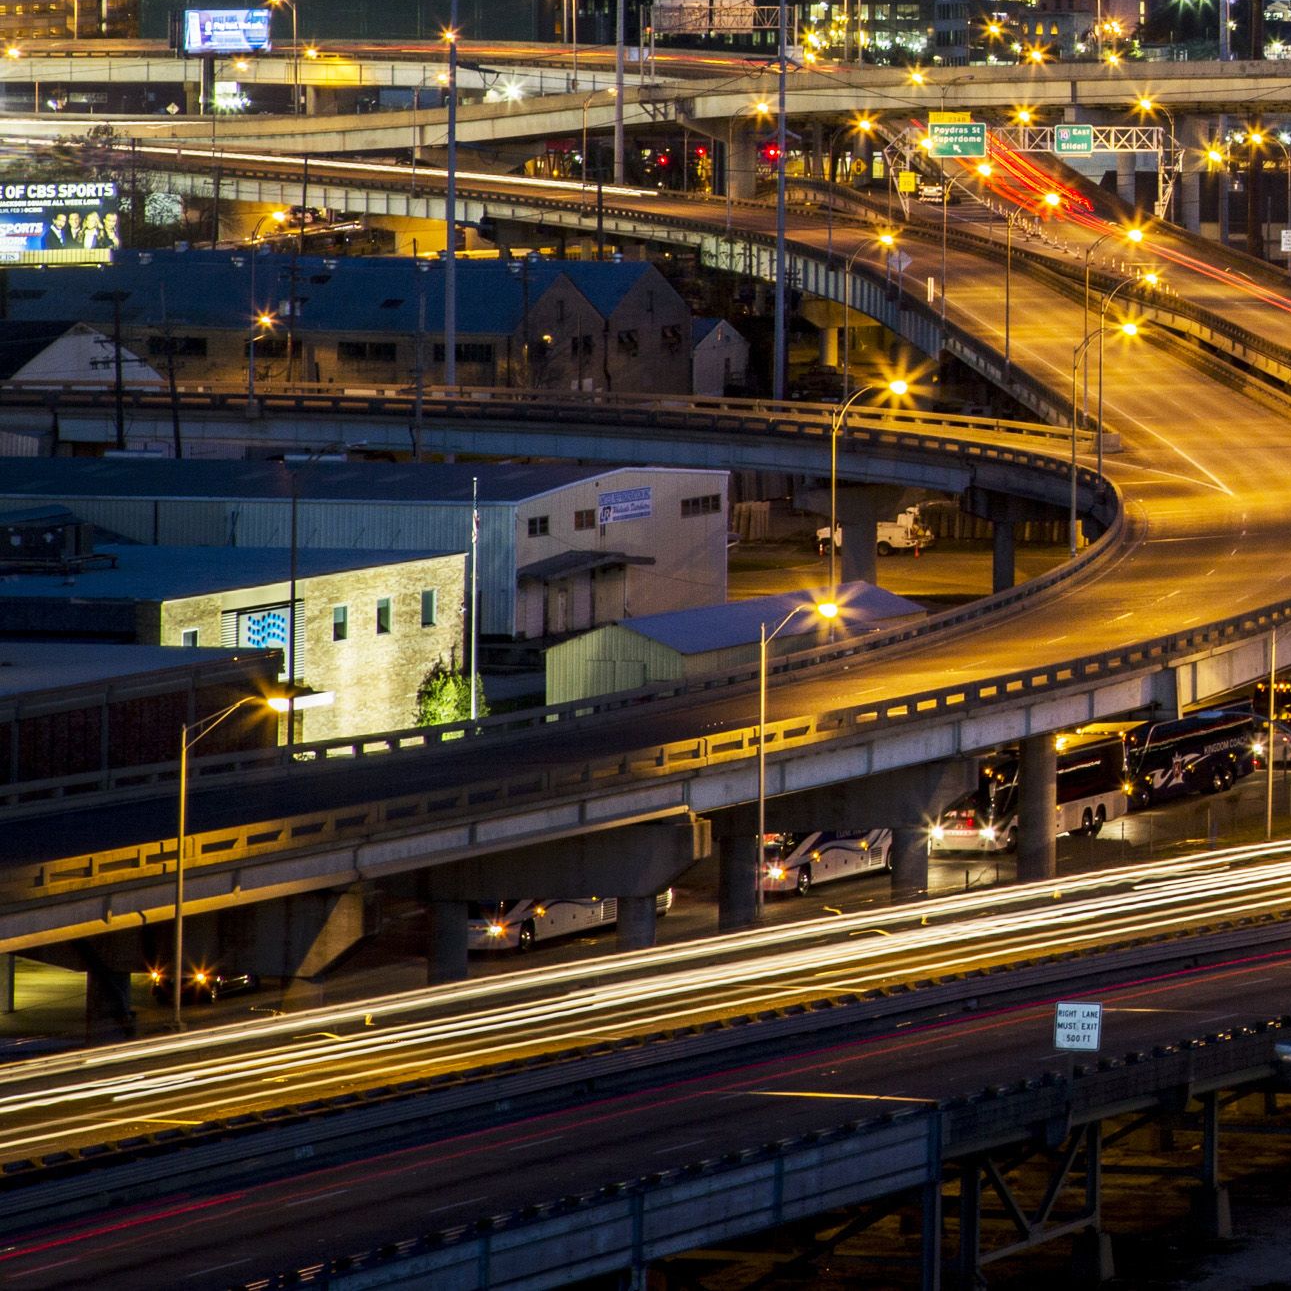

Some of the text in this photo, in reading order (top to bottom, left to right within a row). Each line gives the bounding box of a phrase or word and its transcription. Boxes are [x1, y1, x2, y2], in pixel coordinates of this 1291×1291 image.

[934, 126, 981, 136] Poydras St
[934, 135, 982, 144] Superdome
[1061, 142, 1088, 150] Slidell
[5, 185, 25, 199] OF
[27, 184, 56, 198] CBS
[58, 182, 114, 198] SPORTS
[1058, 1010, 1099, 1018] RIGHT LANE
[1057, 1022, 1098, 1030] MUST EXIT
[1066, 1034, 1091, 1043] 500 FT
